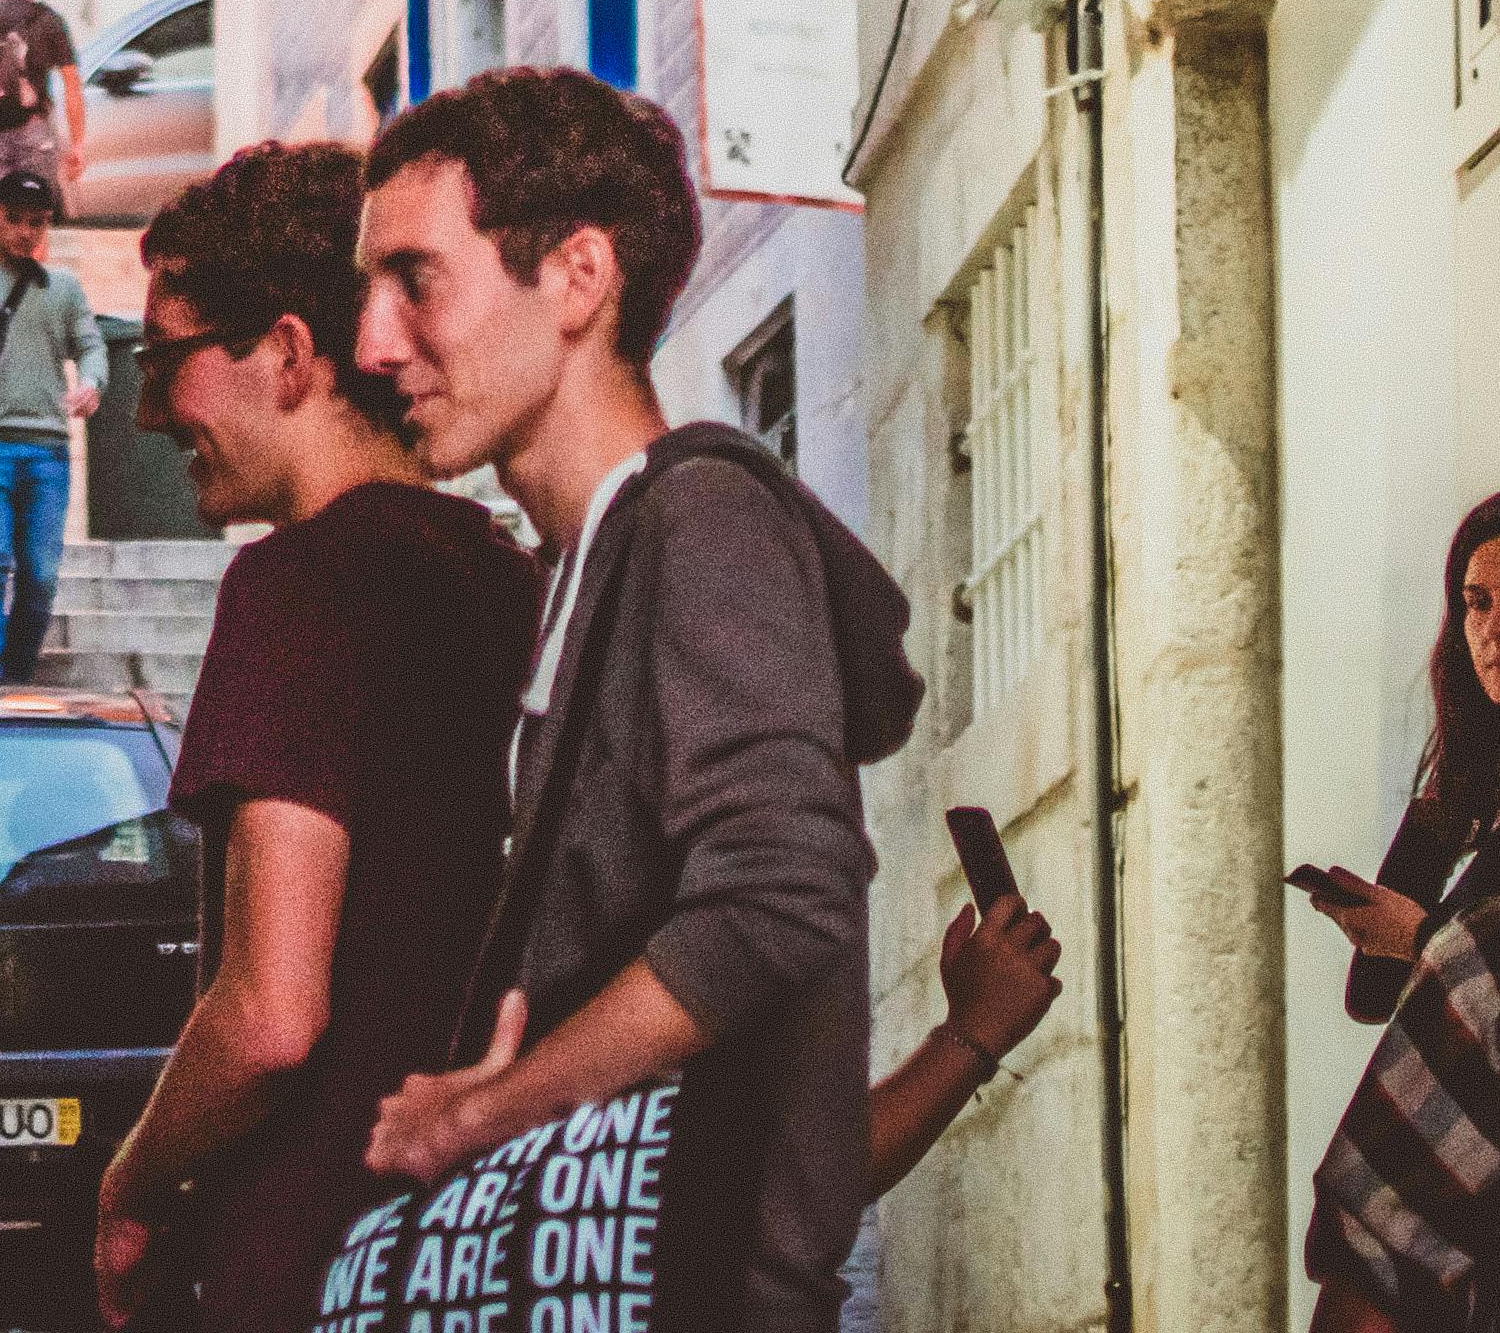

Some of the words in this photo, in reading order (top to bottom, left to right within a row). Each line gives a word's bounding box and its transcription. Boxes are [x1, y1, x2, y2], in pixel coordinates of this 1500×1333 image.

[418, 1168, 532, 1229] ARE
[539, 1146, 669, 1214] ONE
[321, 1237, 399, 1316] WE
[404, 1223, 517, 1303] ARE
[531, 1216, 659, 1290] ONE
